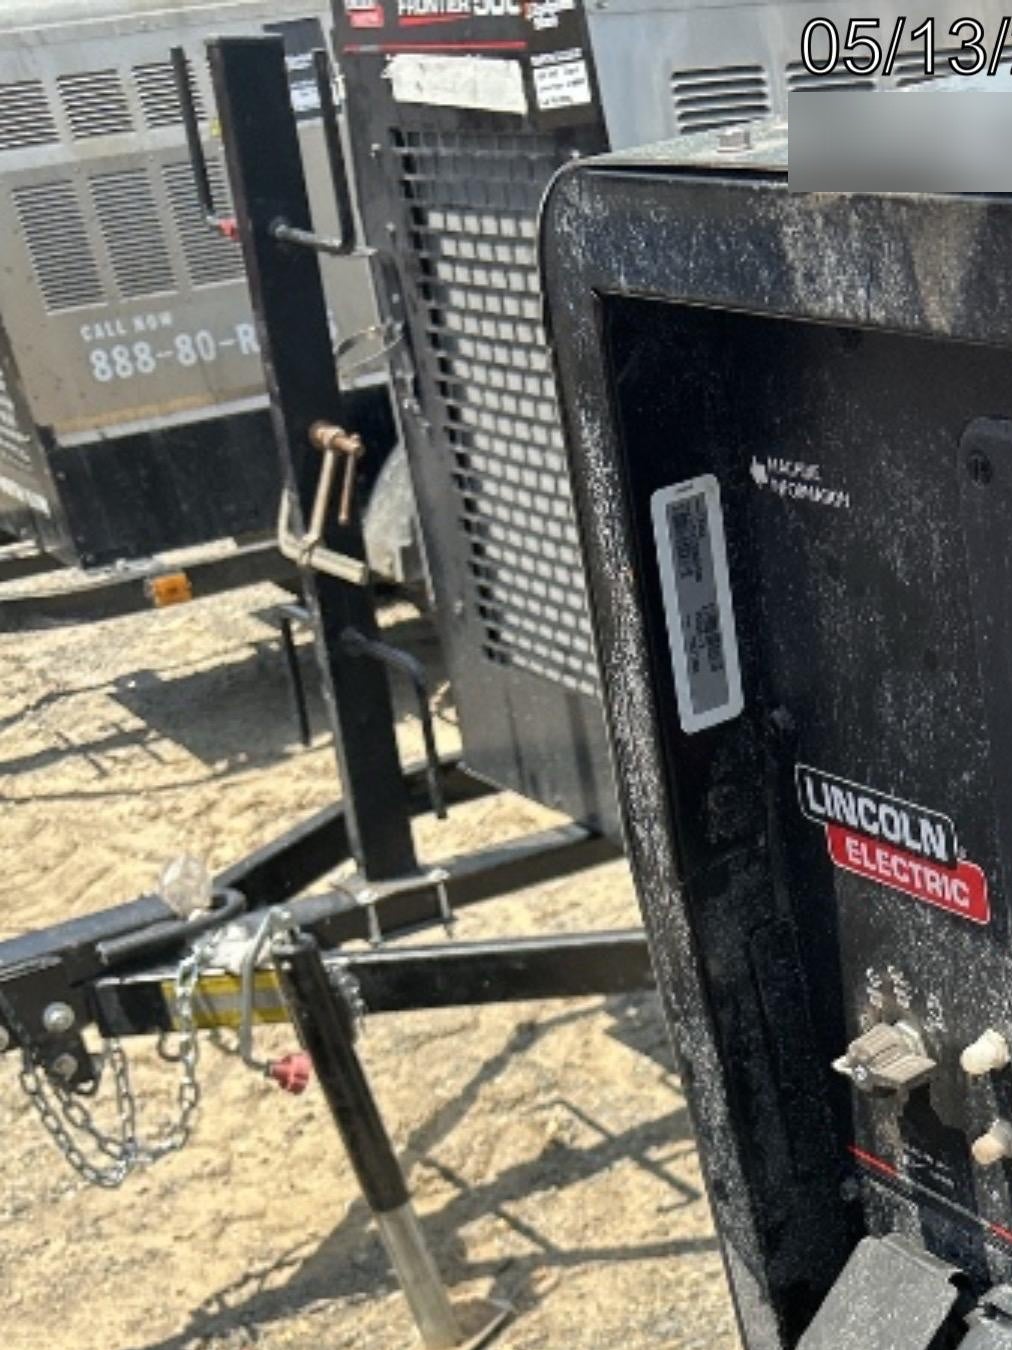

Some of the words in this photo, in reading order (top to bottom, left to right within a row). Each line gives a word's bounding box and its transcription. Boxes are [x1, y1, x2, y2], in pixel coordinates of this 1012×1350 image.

[80, 319, 127, 342] CALL
[805, 775, 949, 862] LINCOLN
[845, 836, 970, 909] ELECTRIC
